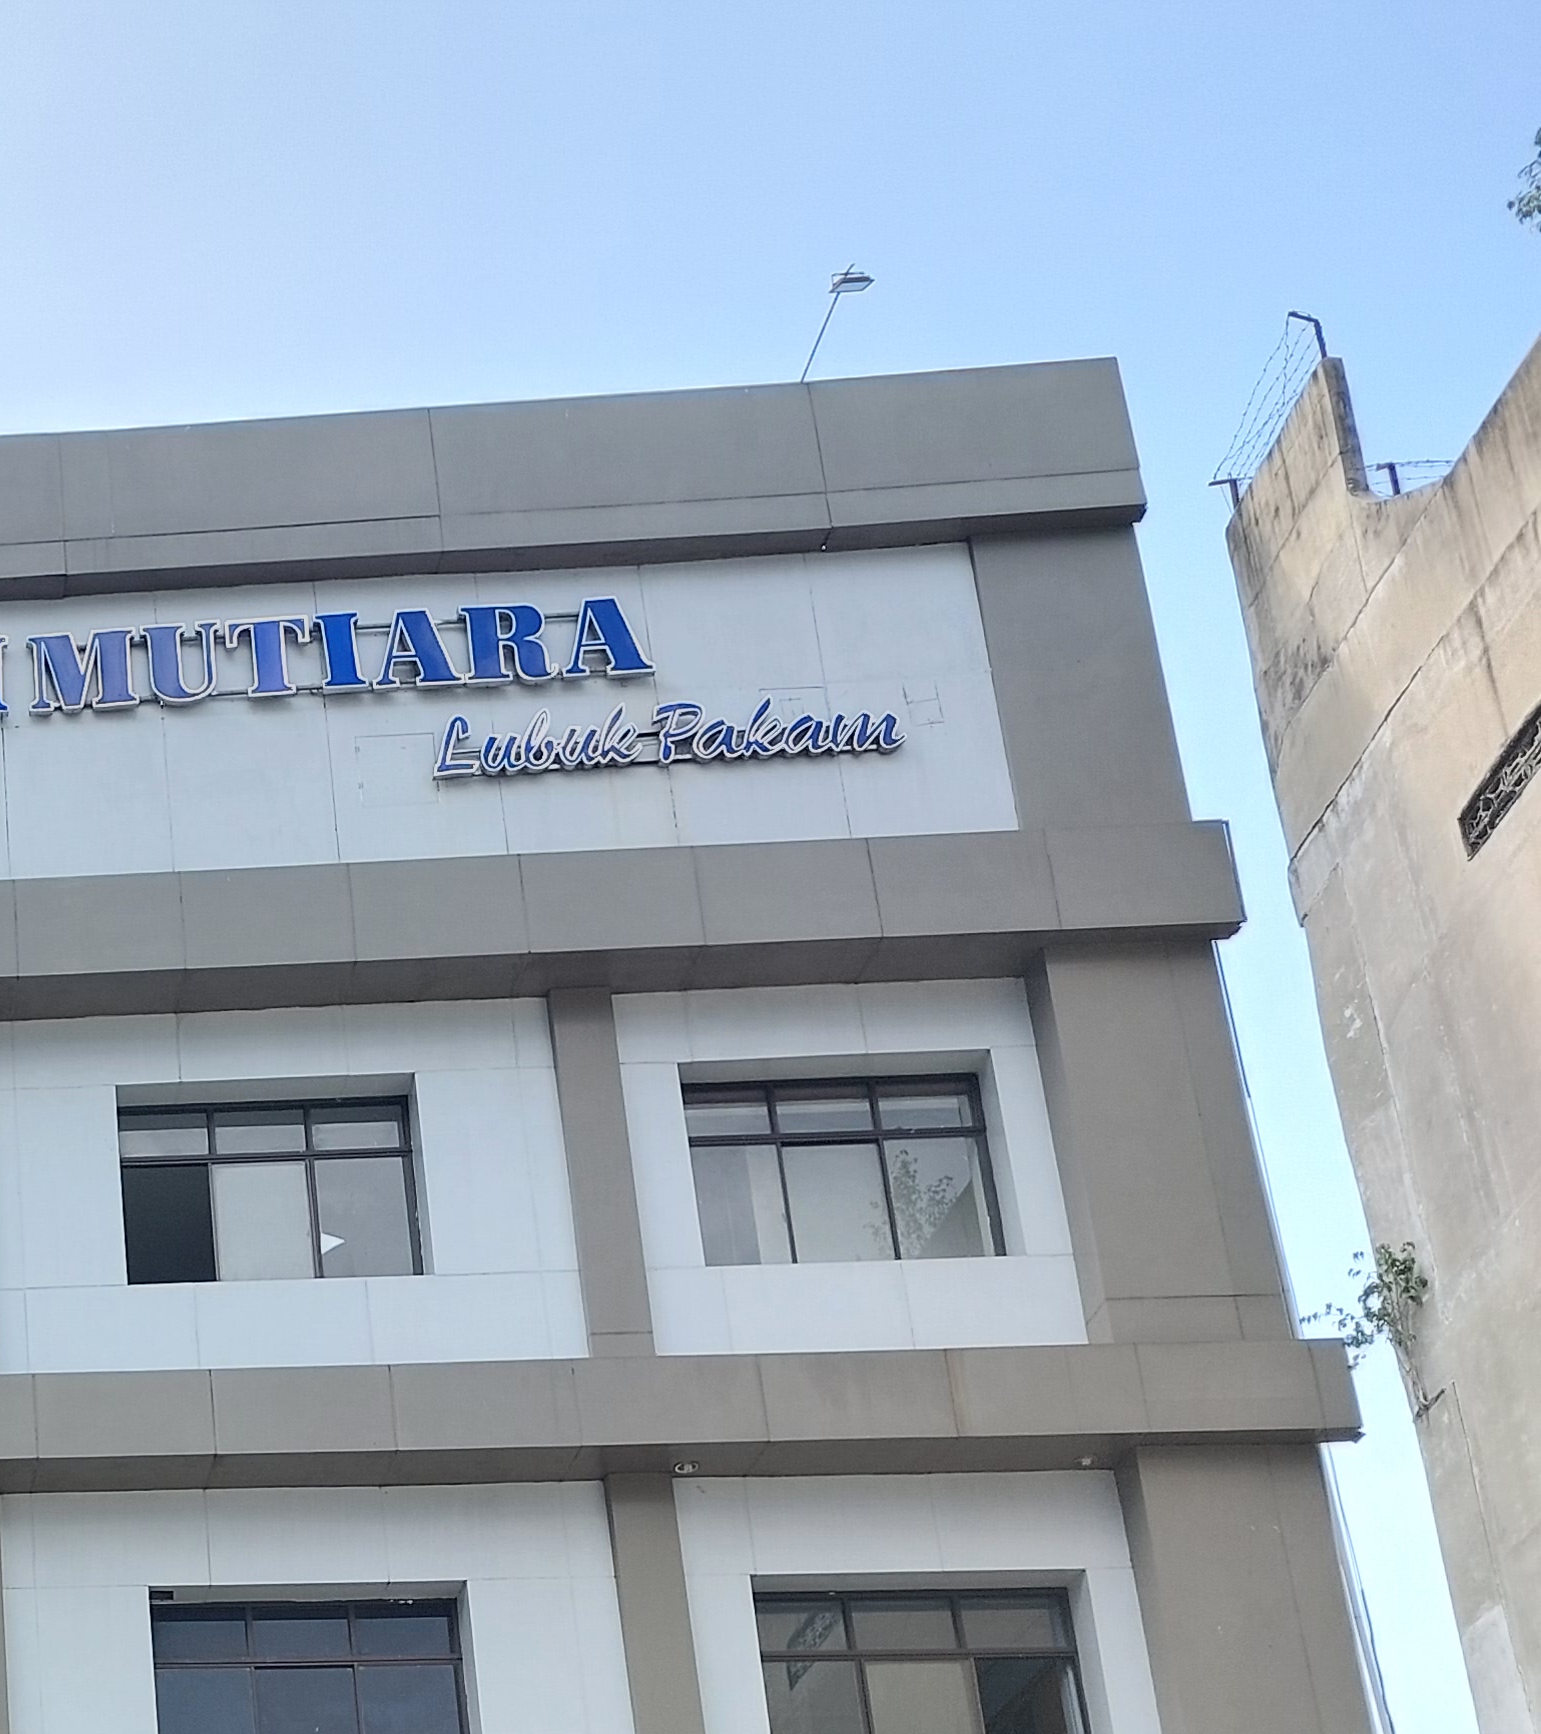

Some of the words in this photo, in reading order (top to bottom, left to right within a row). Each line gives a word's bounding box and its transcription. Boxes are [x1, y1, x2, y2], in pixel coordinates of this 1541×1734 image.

[28, 596, 658, 715] MUTIARA
[432, 703, 644, 781] Lubuk
[652, 696, 907, 769] Pakam
